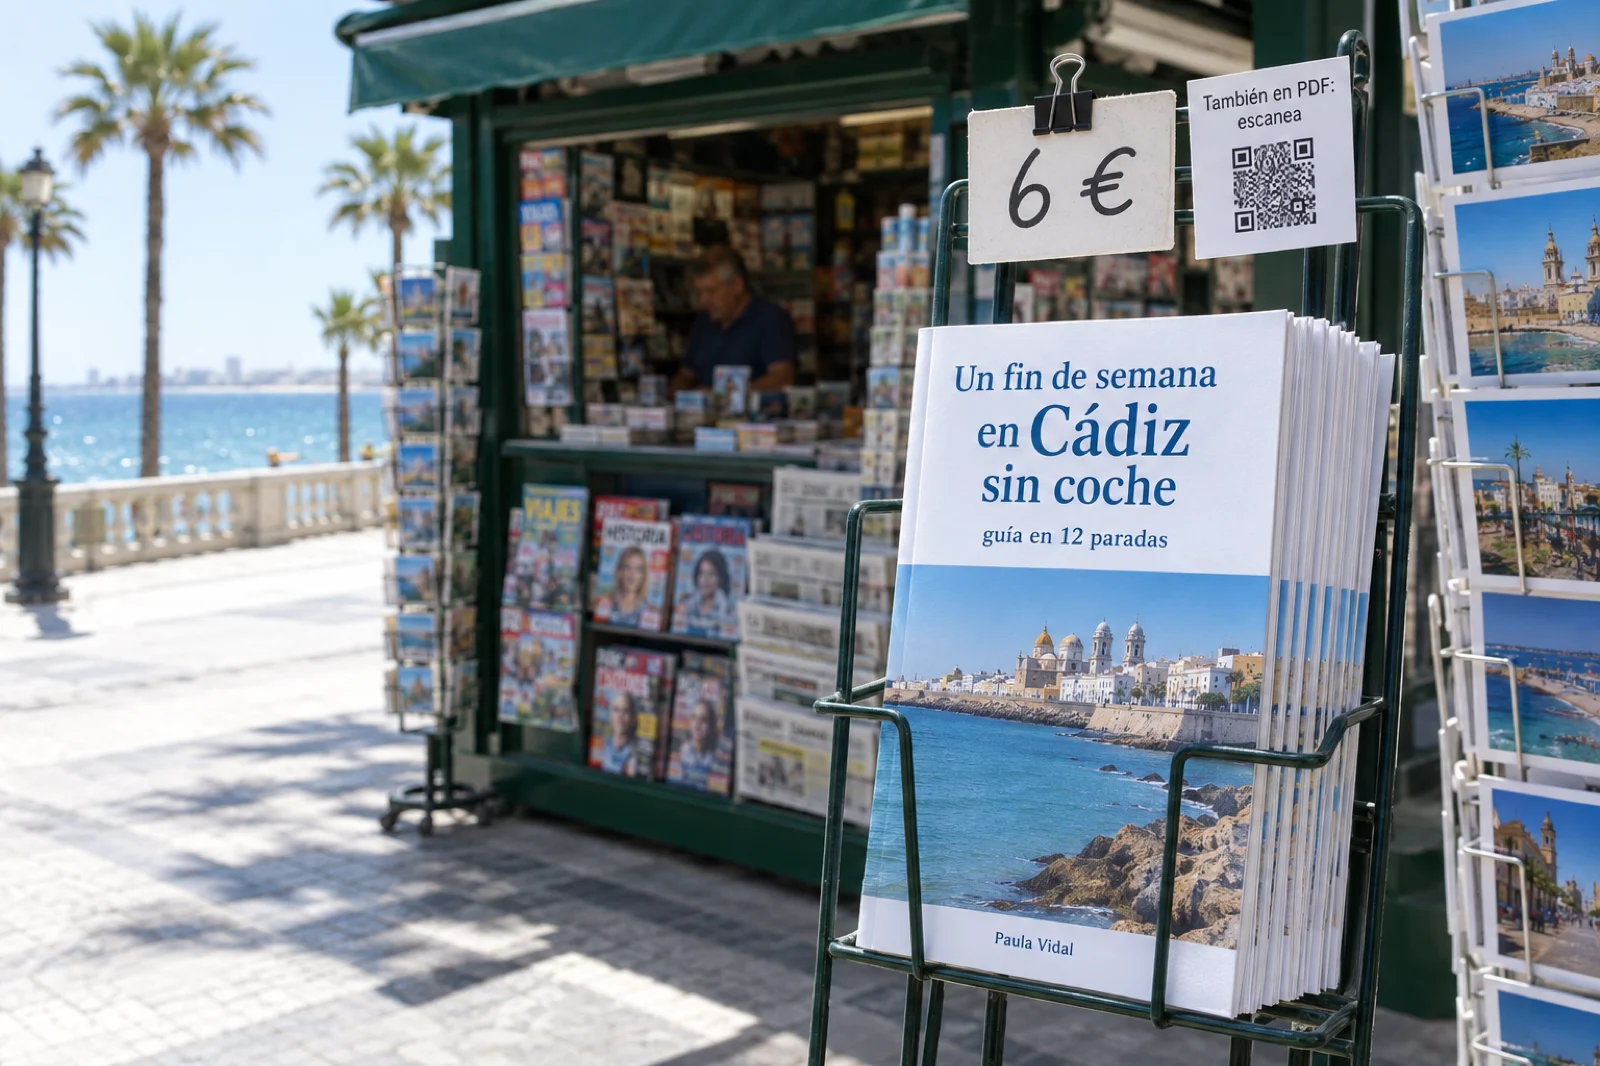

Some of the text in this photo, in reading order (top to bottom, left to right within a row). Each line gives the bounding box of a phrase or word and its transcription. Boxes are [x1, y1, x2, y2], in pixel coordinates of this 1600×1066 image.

[1202, 76, 1336, 112] También en PDF:
[1237, 109, 1302, 130] escanea
[1008, 145, 1137, 229] 6 €
[955, 360, 1218, 393] Un fin de semana
[977, 401, 1191, 458] en Cádiz
[981, 463, 1177, 507] sin coche
[981, 525, 1168, 551] guía en 12 paradas
[994, 930, 1074, 957] Paula Vidal
